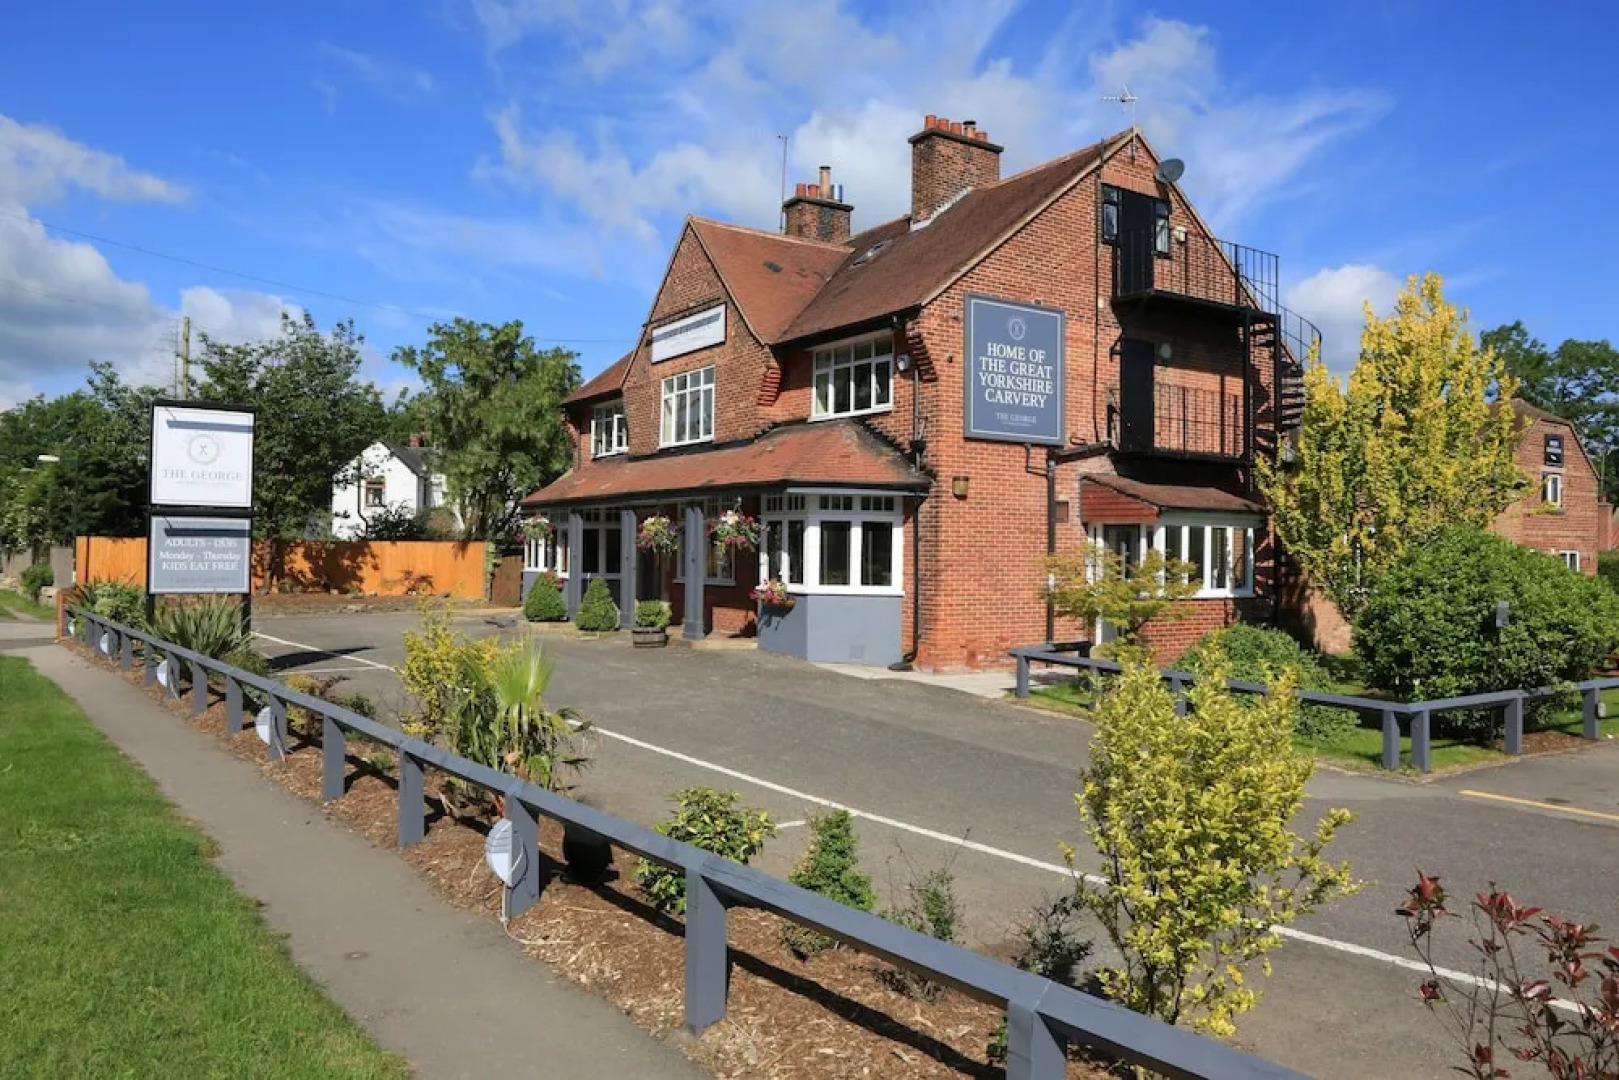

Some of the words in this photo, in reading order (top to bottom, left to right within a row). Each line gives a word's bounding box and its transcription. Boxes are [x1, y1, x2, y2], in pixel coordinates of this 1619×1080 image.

[987, 342, 1026, 361] HOME
[1029, 349, 1047, 363] OF
[979, 356, 1007, 373] THE
[1009, 360, 1053, 380] GREAT
[978, 371, 1054, 395] YORKSHIRE
[985, 388, 1047, 408] CARVERY
[162, 468, 187, 479] THE
[190, 469, 243, 481] GEORGE
[159, 550, 195, 562] Monday
[162, 561, 187, 571] KIDS
[189, 561, 211, 571] EAT
[212, 561, 239, 571] FREE
